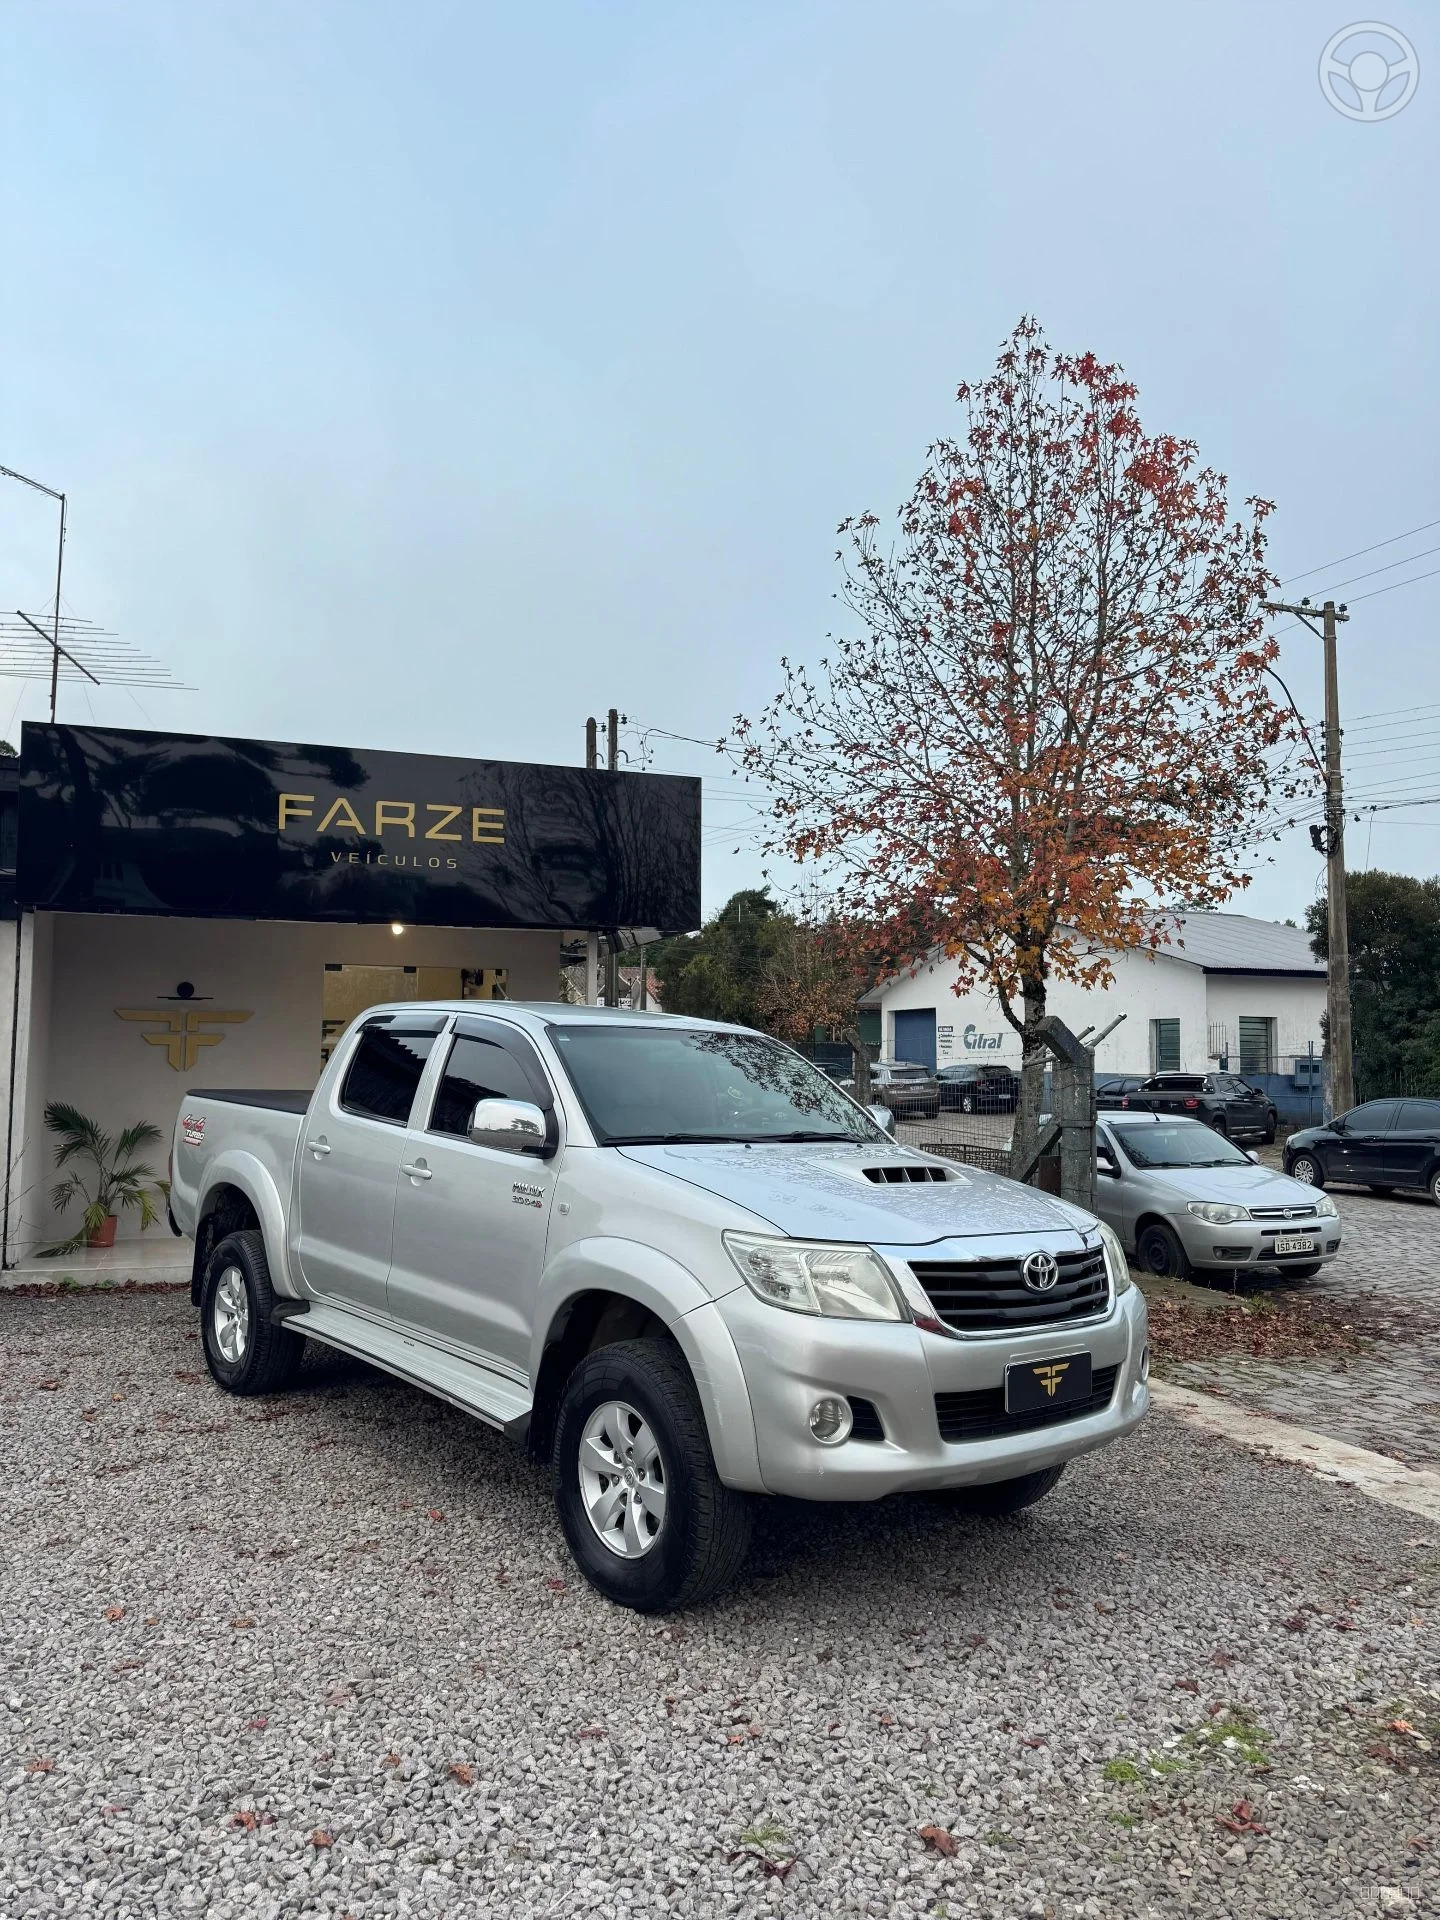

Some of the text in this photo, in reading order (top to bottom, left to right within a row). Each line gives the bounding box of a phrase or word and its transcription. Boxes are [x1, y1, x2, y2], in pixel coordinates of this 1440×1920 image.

[278, 793, 505, 844] FARZE
[331, 850, 457, 869] VEÍCULOS
[186, 1129, 205, 1140] TURBO
